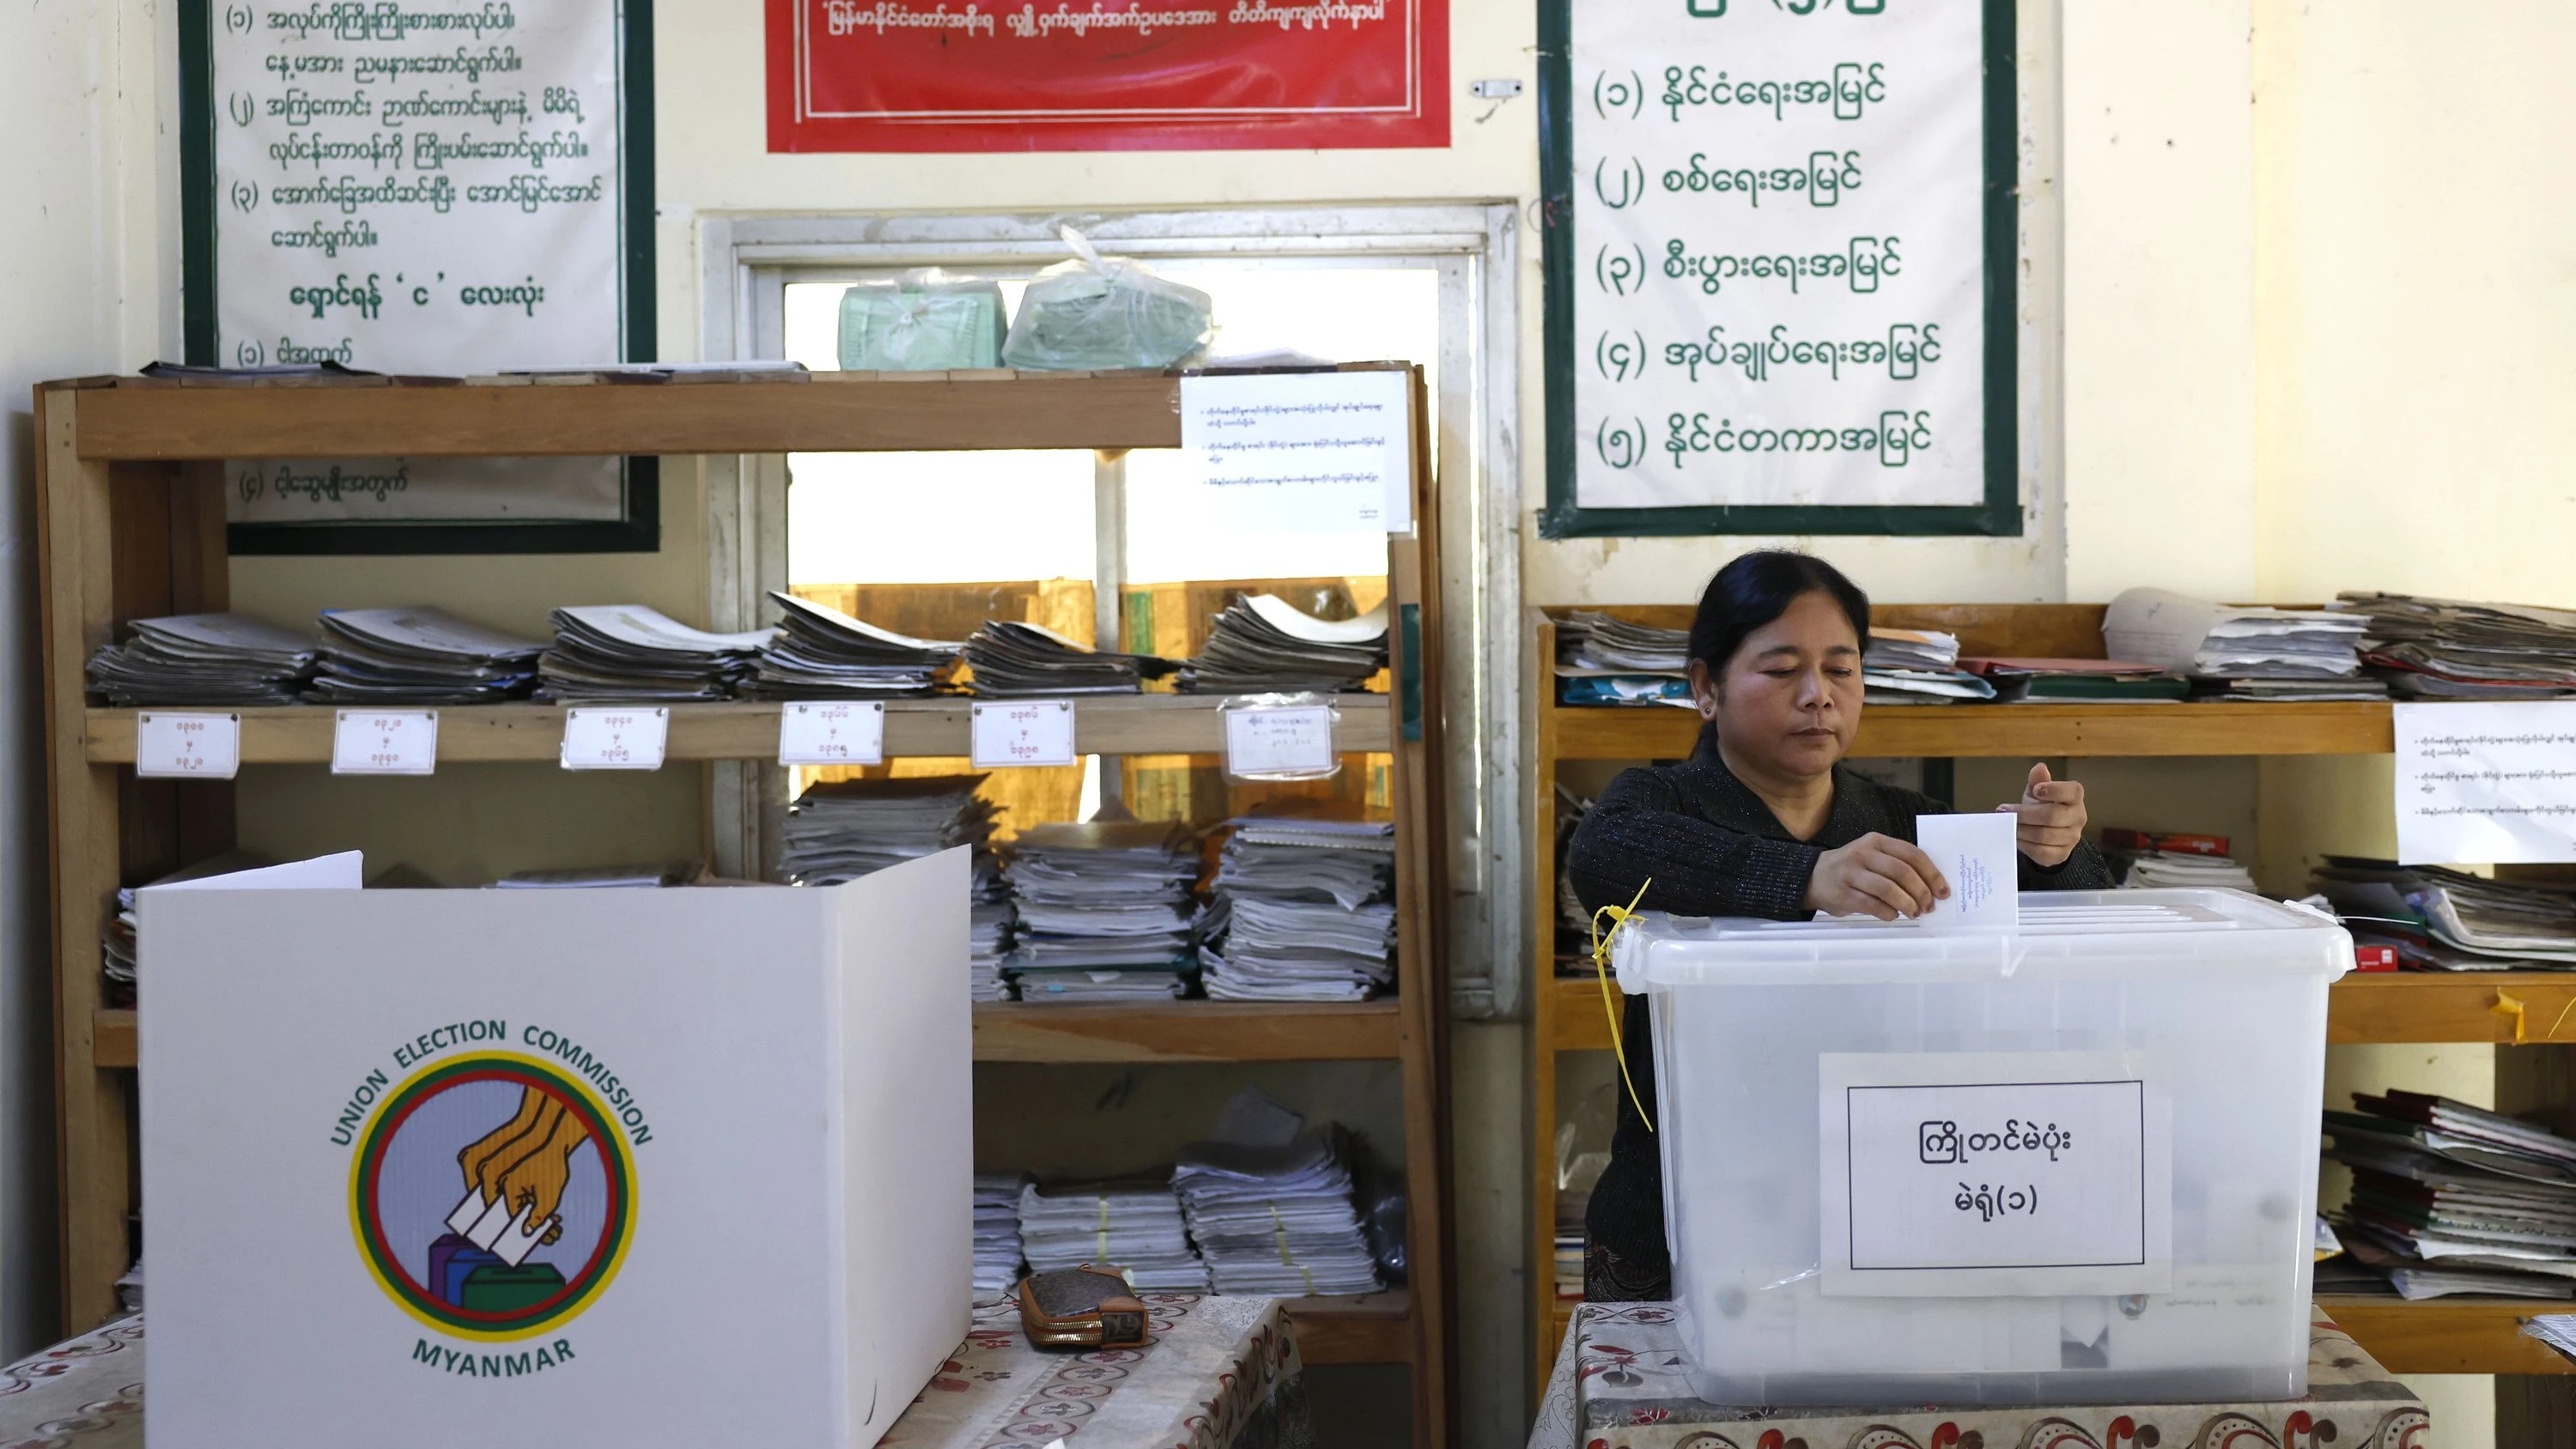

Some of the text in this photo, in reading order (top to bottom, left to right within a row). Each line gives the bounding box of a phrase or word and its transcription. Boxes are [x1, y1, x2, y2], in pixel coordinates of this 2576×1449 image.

[226, 3, 253, 34] (၁)
[229, 92, 255, 128] (၂)
[266, 87, 372, 126] အကြံကောင်း
[542, 85, 585, 125] မိမိရဲ့
[1593, 62, 1885, 123] (၁) နိုင်ငံရေးအမြင်
[269, 130, 403, 172] လုပ်ငန်းတာဝန်ကို
[231, 179, 258, 214] (၃)
[466, 173, 602, 215] အောင်မြင်အောင်
[1595, 149, 1862, 210] (၂) စစ်ရေးအမြင်
[270, 219, 378, 259] ဆောင်ရွက်ပါ။
[1596, 235, 1901, 296] (၃) စီးပွားရေးအမြင်
[289, 272, 382, 320] ရှောင်ရန်
[460, 275, 544, 318] လေးလုံး
[235, 336, 352, 367] (၁) ငါအတက်
[1596, 322, 1941, 383] (၄) အုပ်ချုပ်ရေးအမြင်
[1596, 409, 1931, 470] (၅) နိုင်ငံတကာအမြင်
[239, 470, 264, 503] (၄)
[331, 1019, 653, 1147] UNION ELECTION COMMISSION
[1919, 1119, 2071, 1164] ကြိုတင်မဲပုံး
[1954, 1181, 2038, 1223] မဲရုံ(၁)
[411, 1337, 576, 1379] MYANMAR
